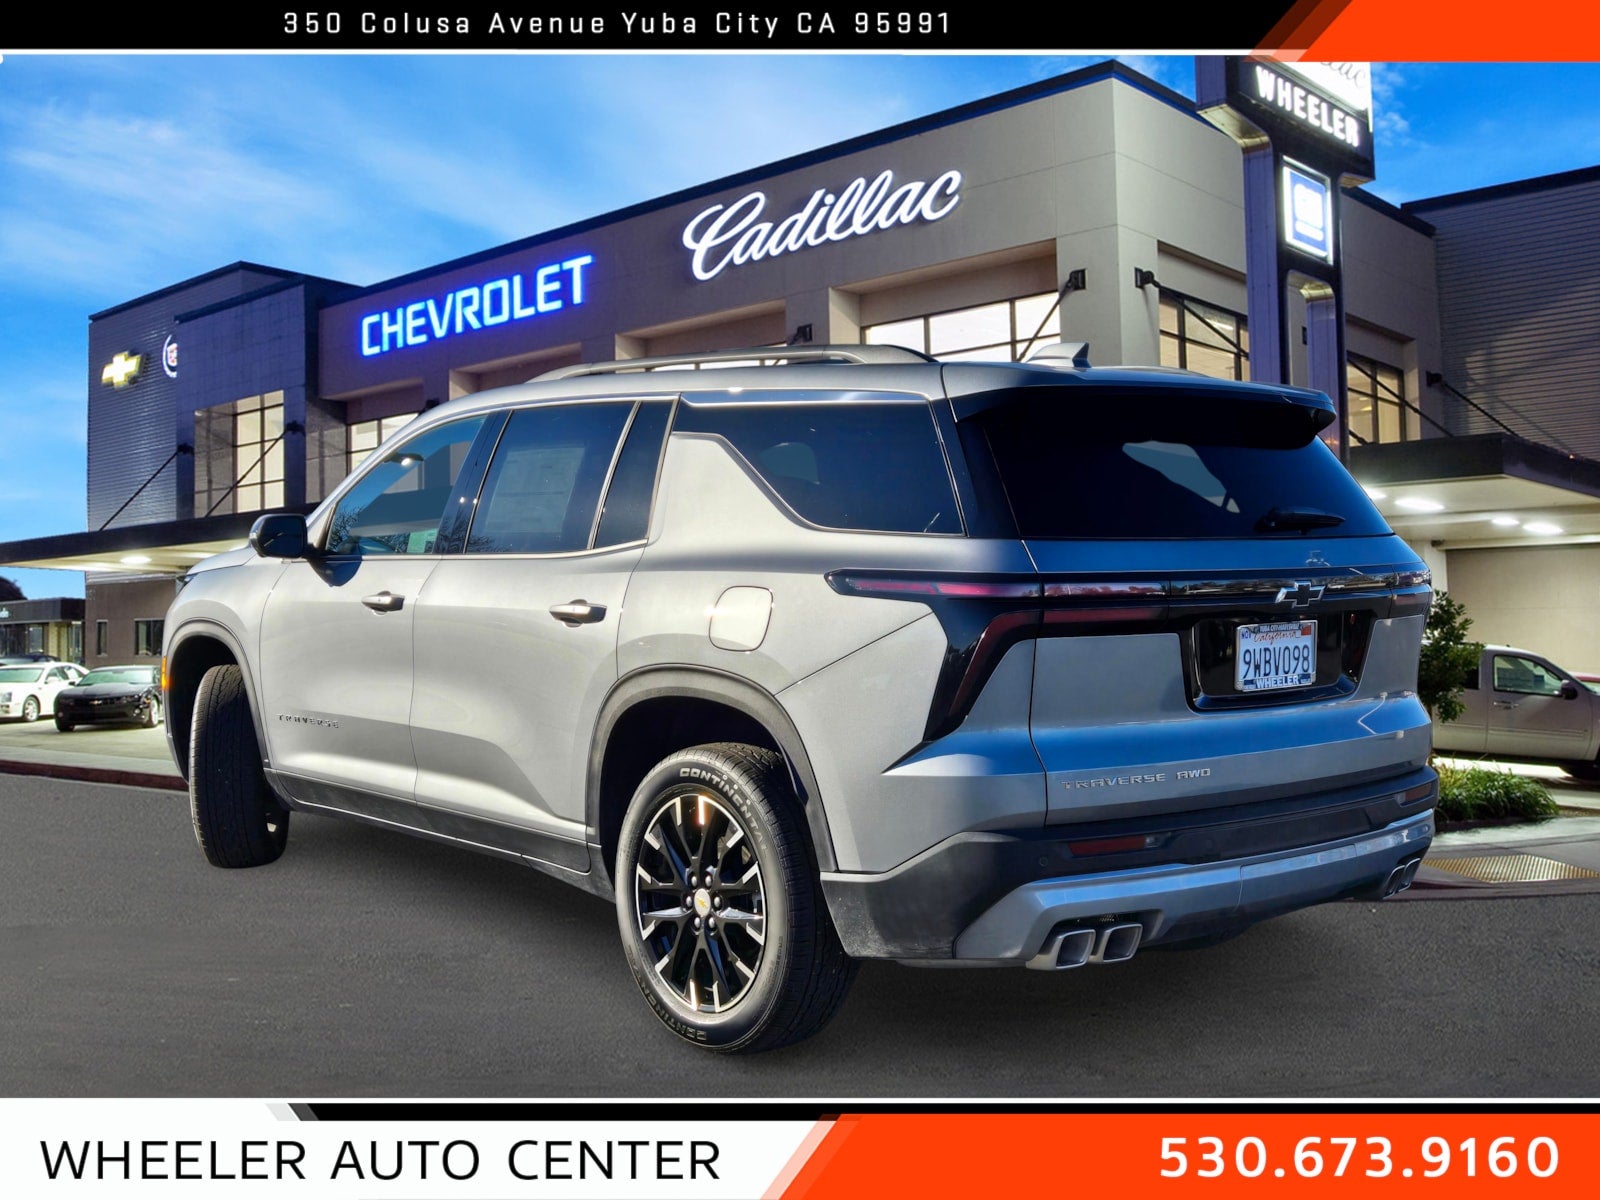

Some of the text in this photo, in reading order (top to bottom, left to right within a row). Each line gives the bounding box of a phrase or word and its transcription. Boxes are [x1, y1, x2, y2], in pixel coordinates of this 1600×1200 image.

[1256, 65, 1360, 147] WHEELER
[682, 169, 963, 281] Cadillac
[360, 254, 593, 357] CHEVROLET
[1242, 644, 1310, 679] 9WBV098
[1256, 675, 1299, 689] WHEELER
[1061, 767, 1211, 790] TRAVERSE AWD
